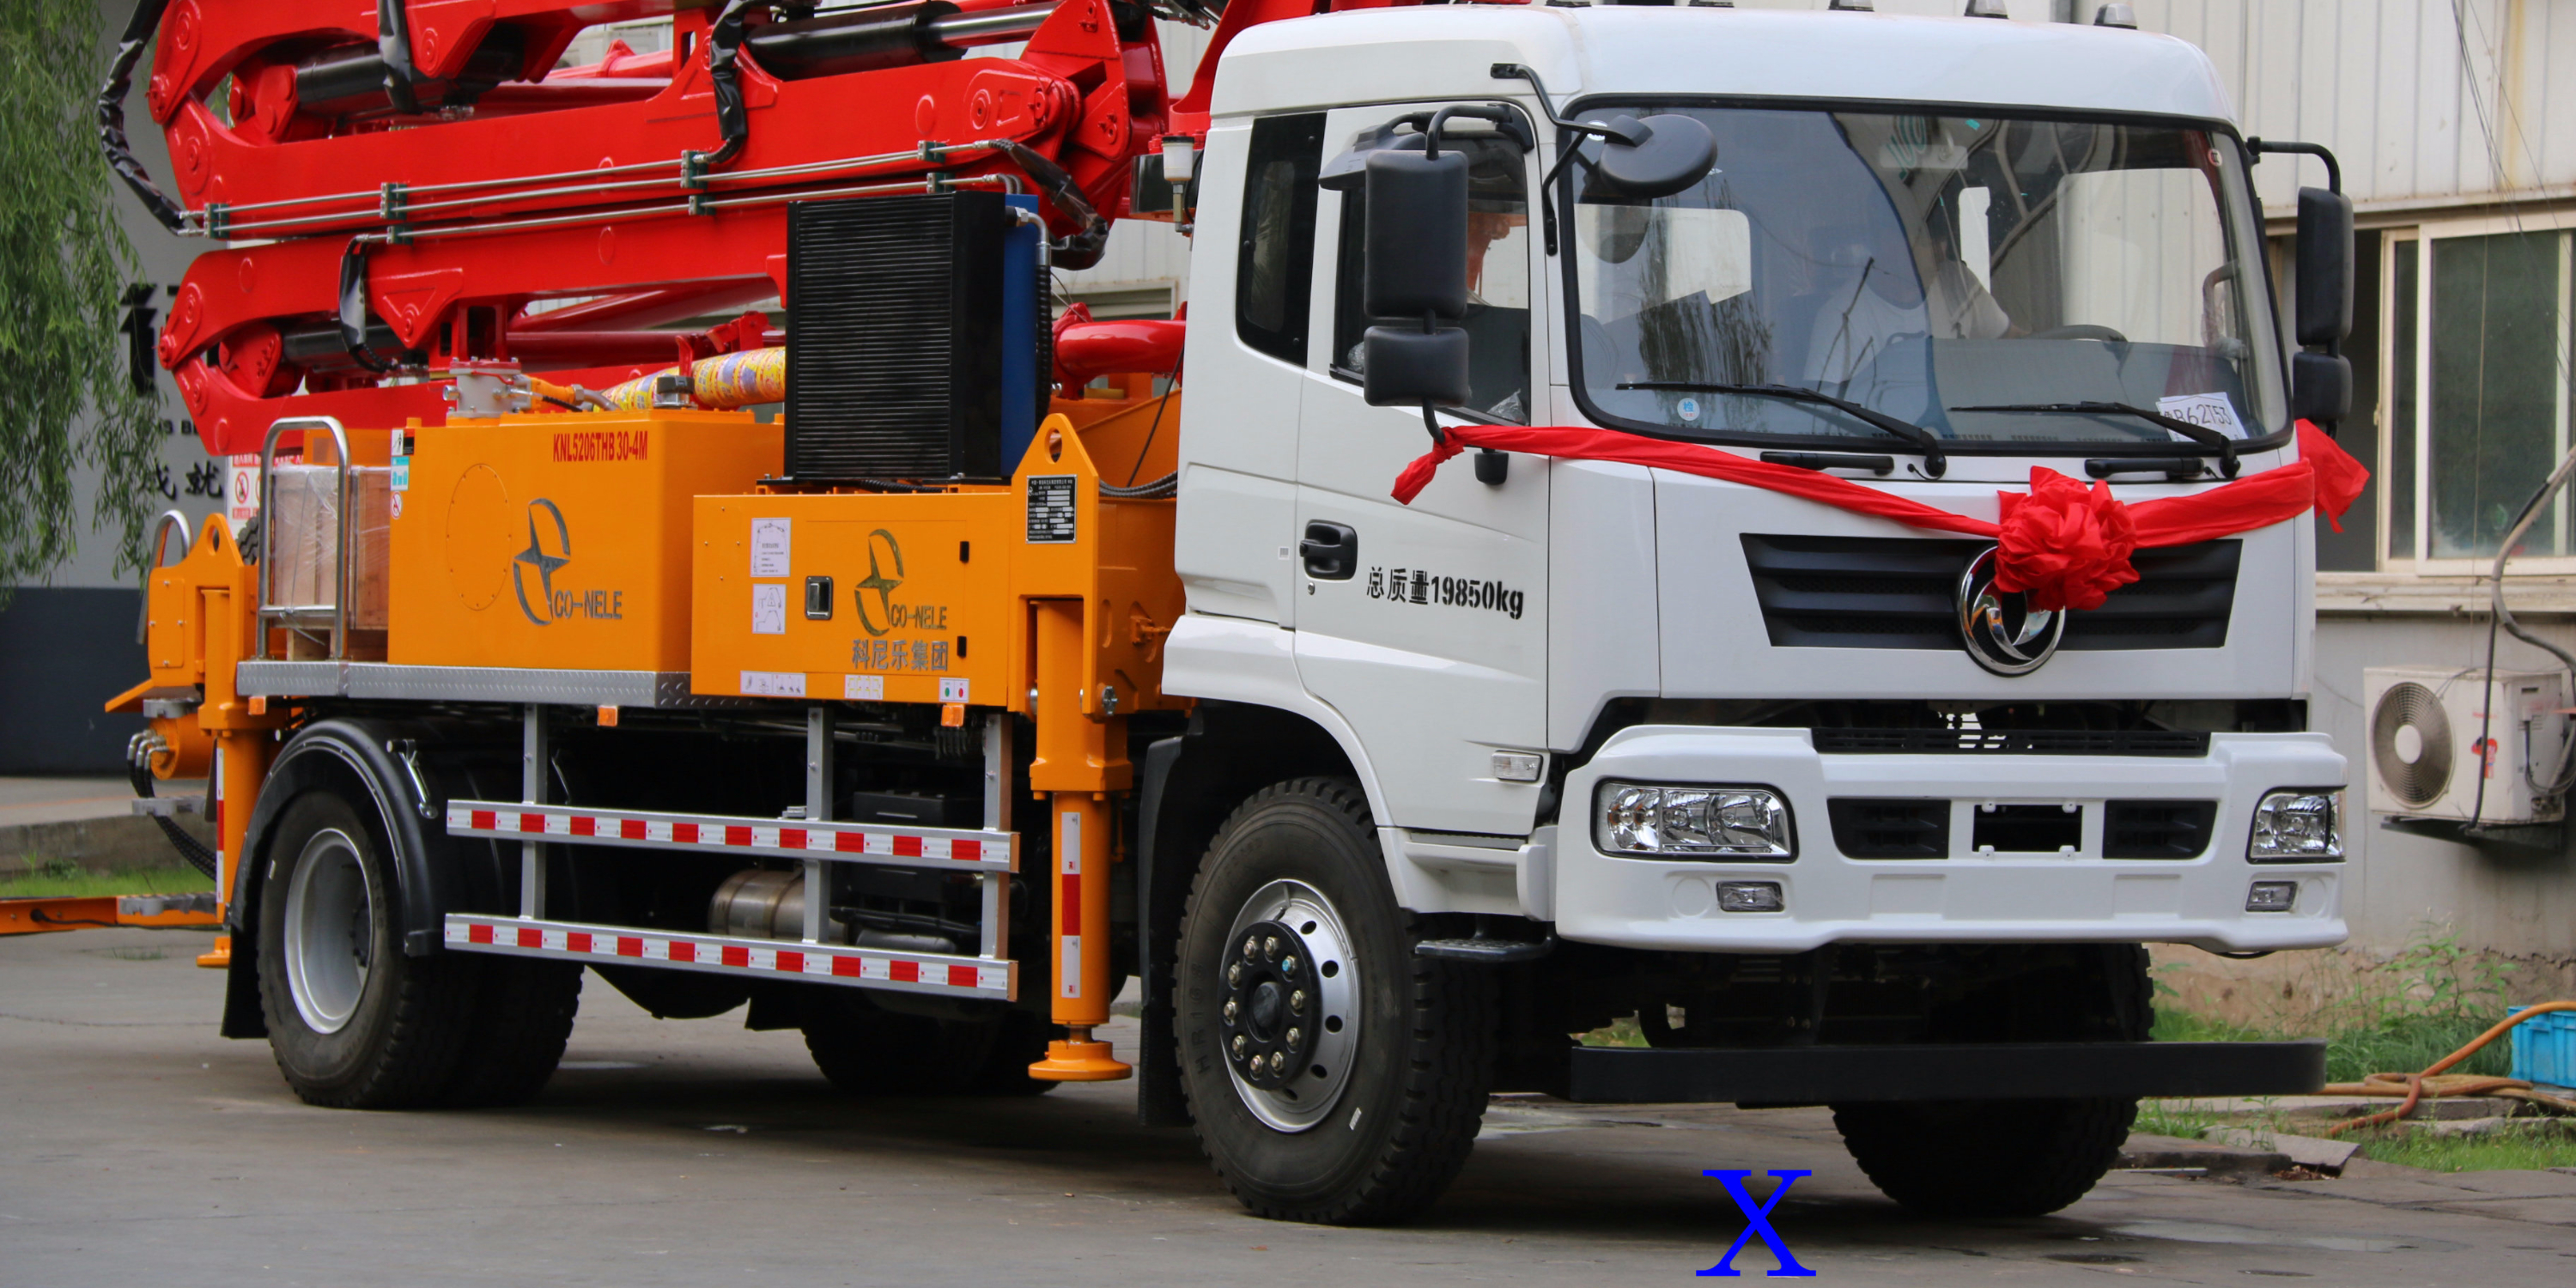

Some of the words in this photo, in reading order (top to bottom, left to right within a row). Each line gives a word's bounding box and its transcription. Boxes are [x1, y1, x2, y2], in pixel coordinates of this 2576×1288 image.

[553, 432, 616, 462] KNL5206THB
[617, 430, 648, 461] 30-4M
[553, 589, 623, 620] CO-NELE
[1367, 567, 1524, 620] 总质量19850kg
[890, 604, 948, 630] CO-NELE
[852, 638, 949, 672] 科尼乐集团
